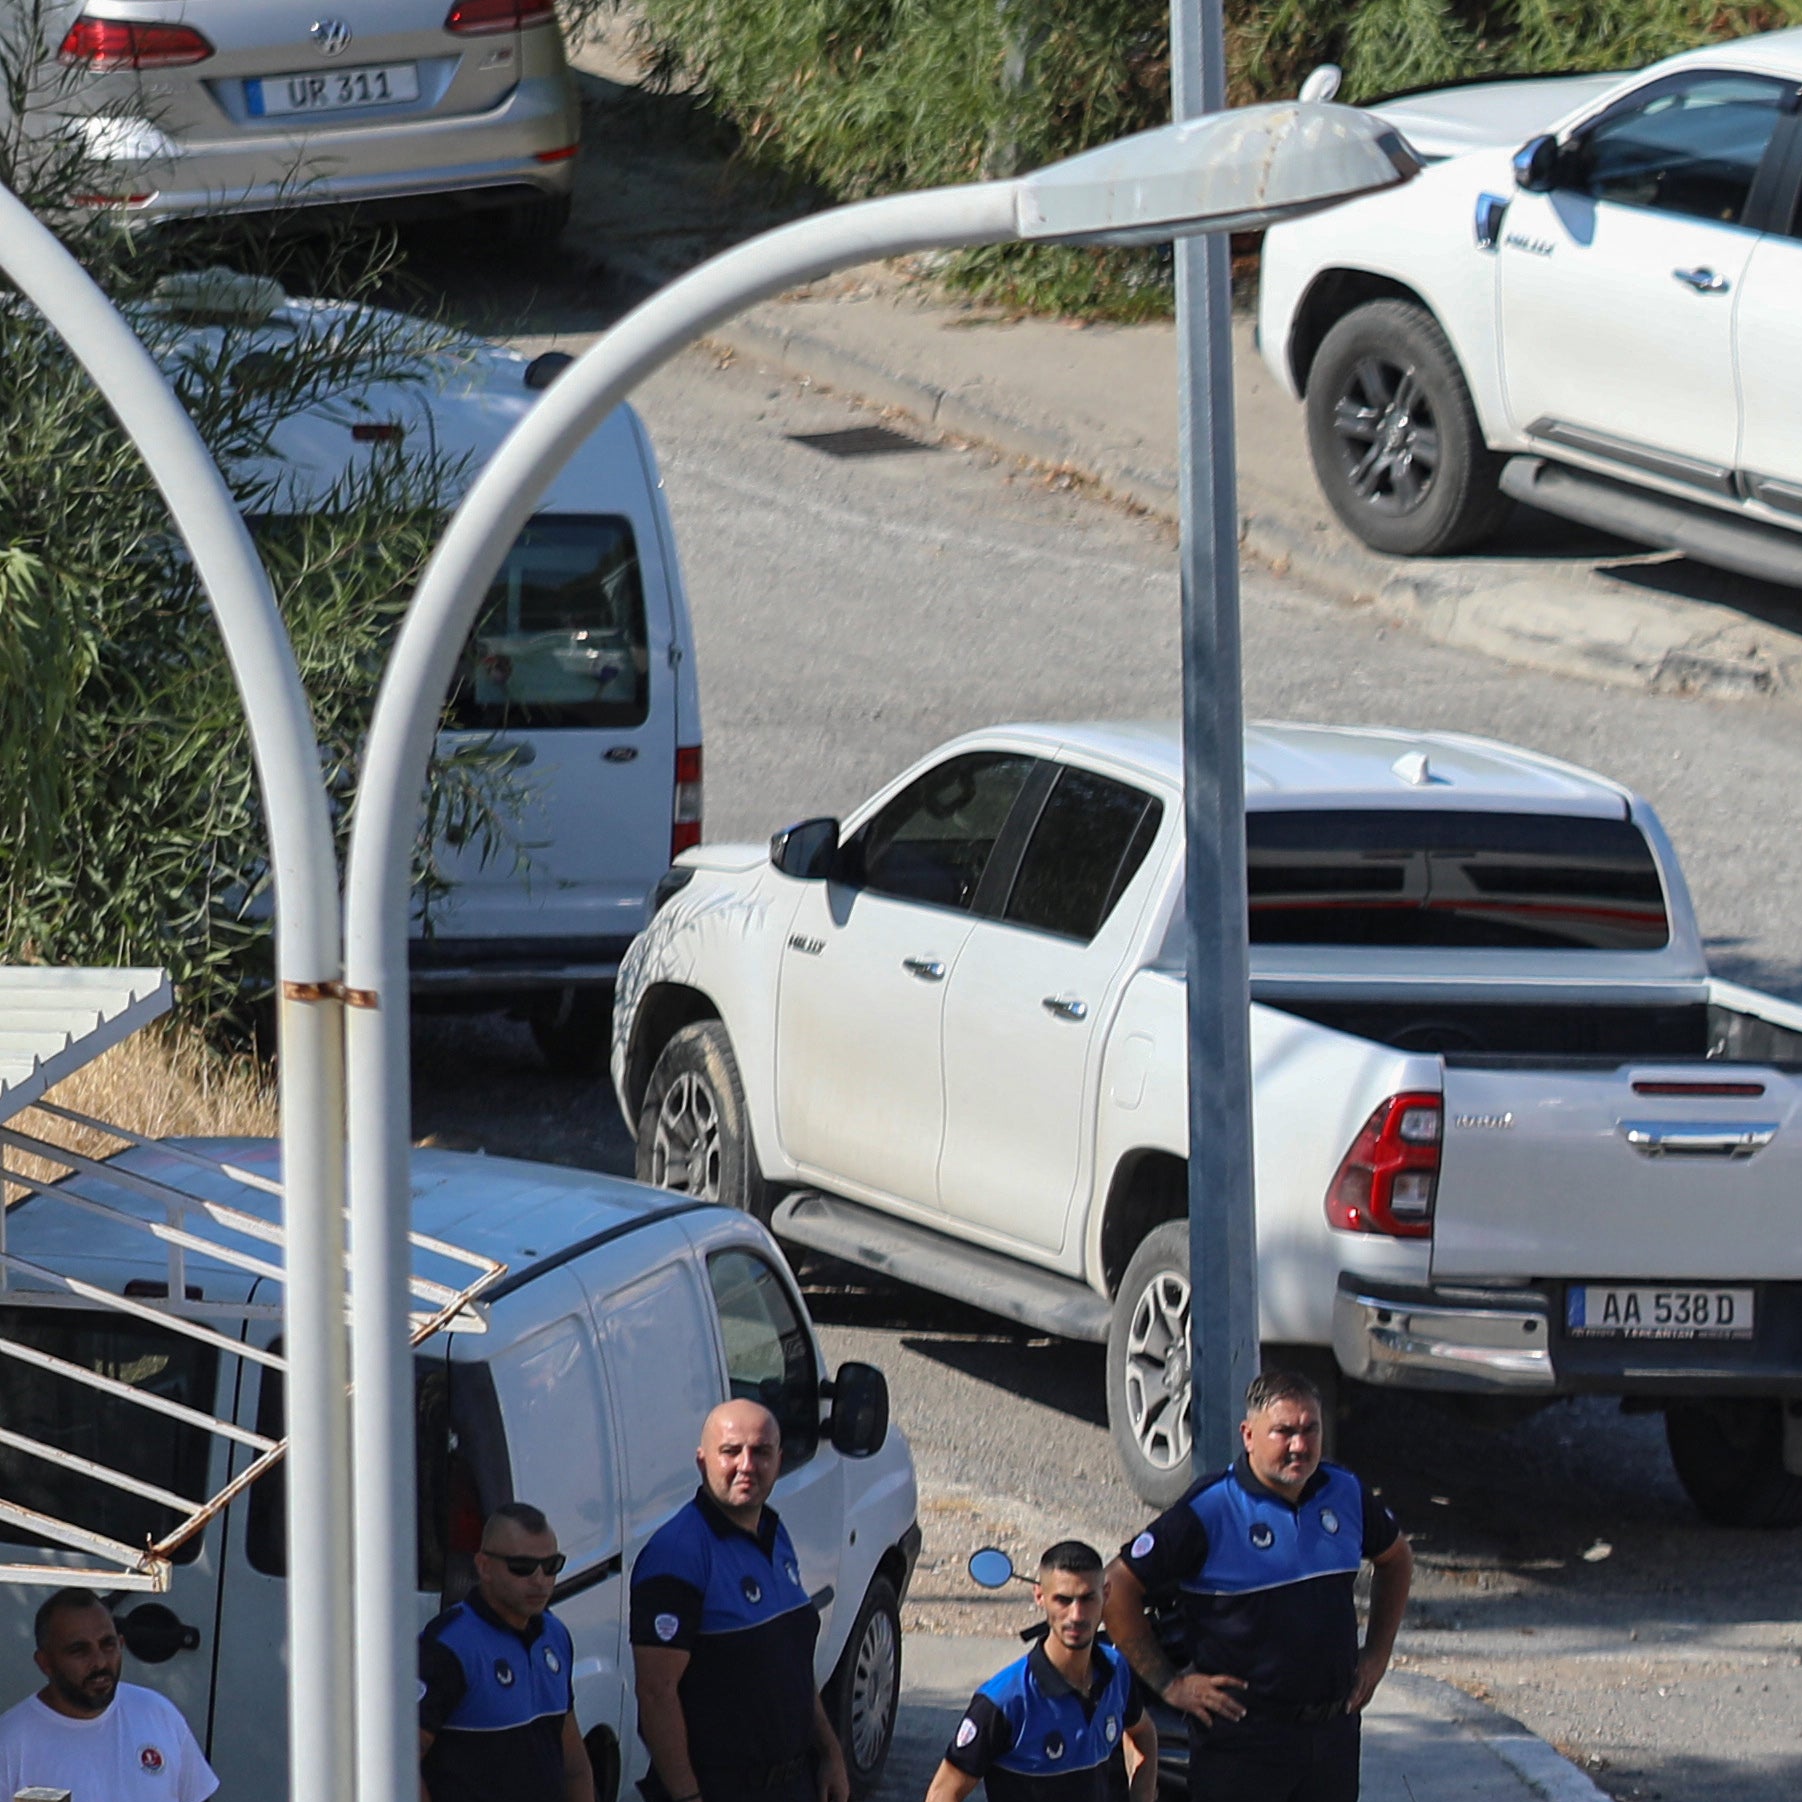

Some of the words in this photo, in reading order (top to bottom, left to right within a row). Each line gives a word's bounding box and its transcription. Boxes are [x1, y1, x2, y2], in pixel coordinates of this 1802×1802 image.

[288, 82, 324, 108] UR
[338, 71, 392, 101] 311
[1603, 1293, 1641, 1324] AA
[1654, 1293, 1709, 1325] 538
[1716, 1295, 1735, 1325] D
